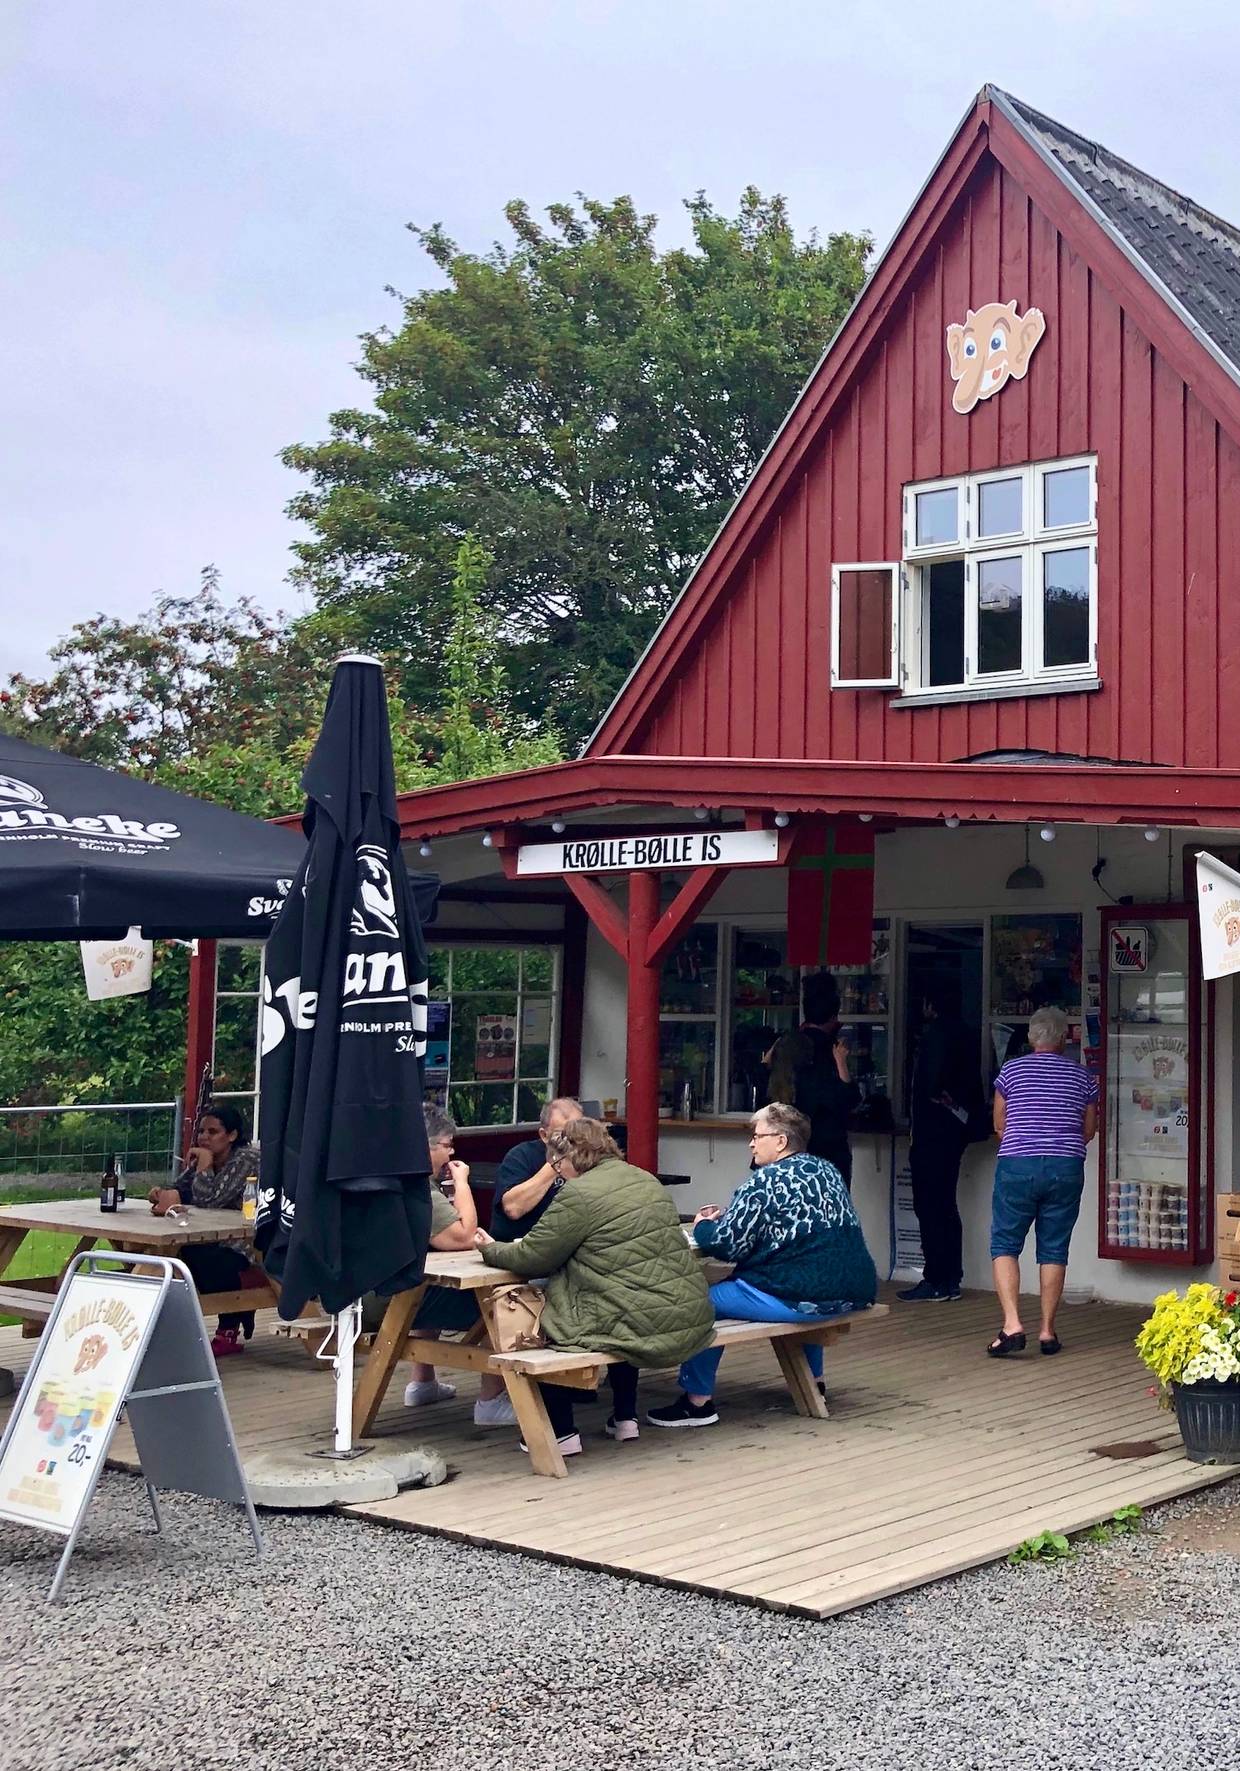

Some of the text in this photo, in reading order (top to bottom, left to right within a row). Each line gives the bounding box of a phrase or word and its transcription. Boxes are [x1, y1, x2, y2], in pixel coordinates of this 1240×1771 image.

[79, 842, 149, 855] Slow beer
[562, 834, 722, 869] KRØLLE-BØLLE IS
[67, 1443, 92, 1467] 20,-
